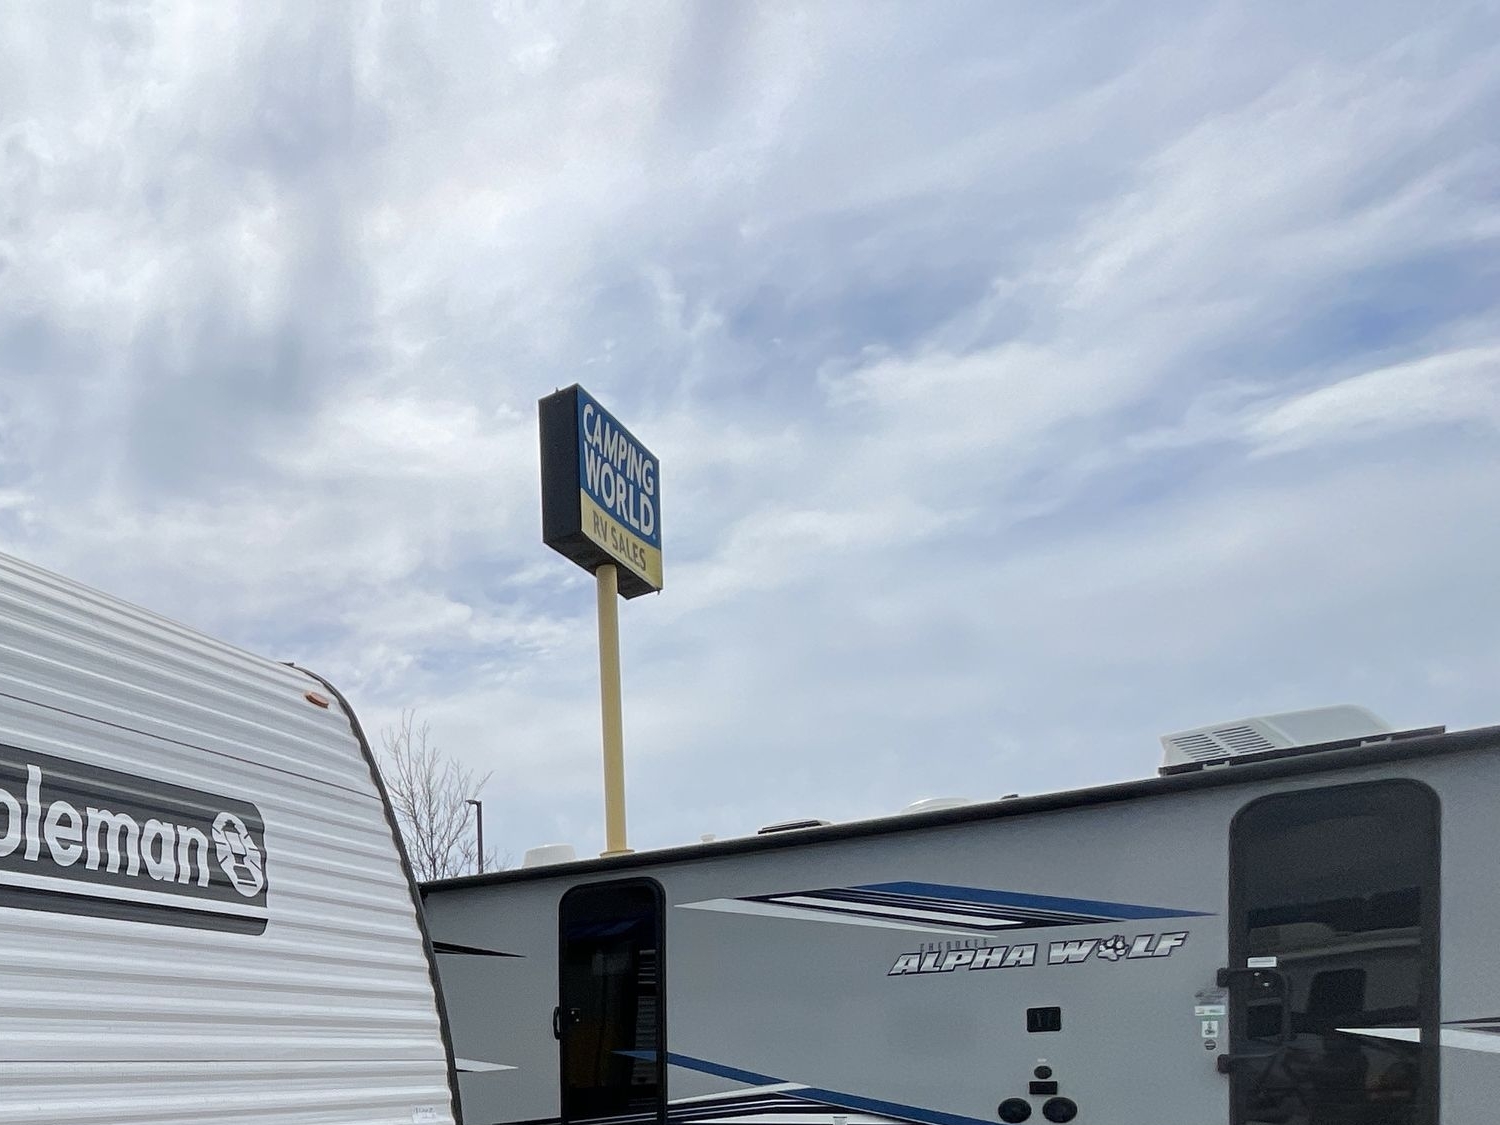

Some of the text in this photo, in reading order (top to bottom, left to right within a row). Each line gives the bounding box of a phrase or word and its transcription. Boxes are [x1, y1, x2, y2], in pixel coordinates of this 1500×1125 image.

[583, 403, 654, 496] CAMPING
[584, 440, 655, 536] WORLD
[592, 510, 647, 572] RV SALES
[887, 943, 1038, 976] ALPHA
